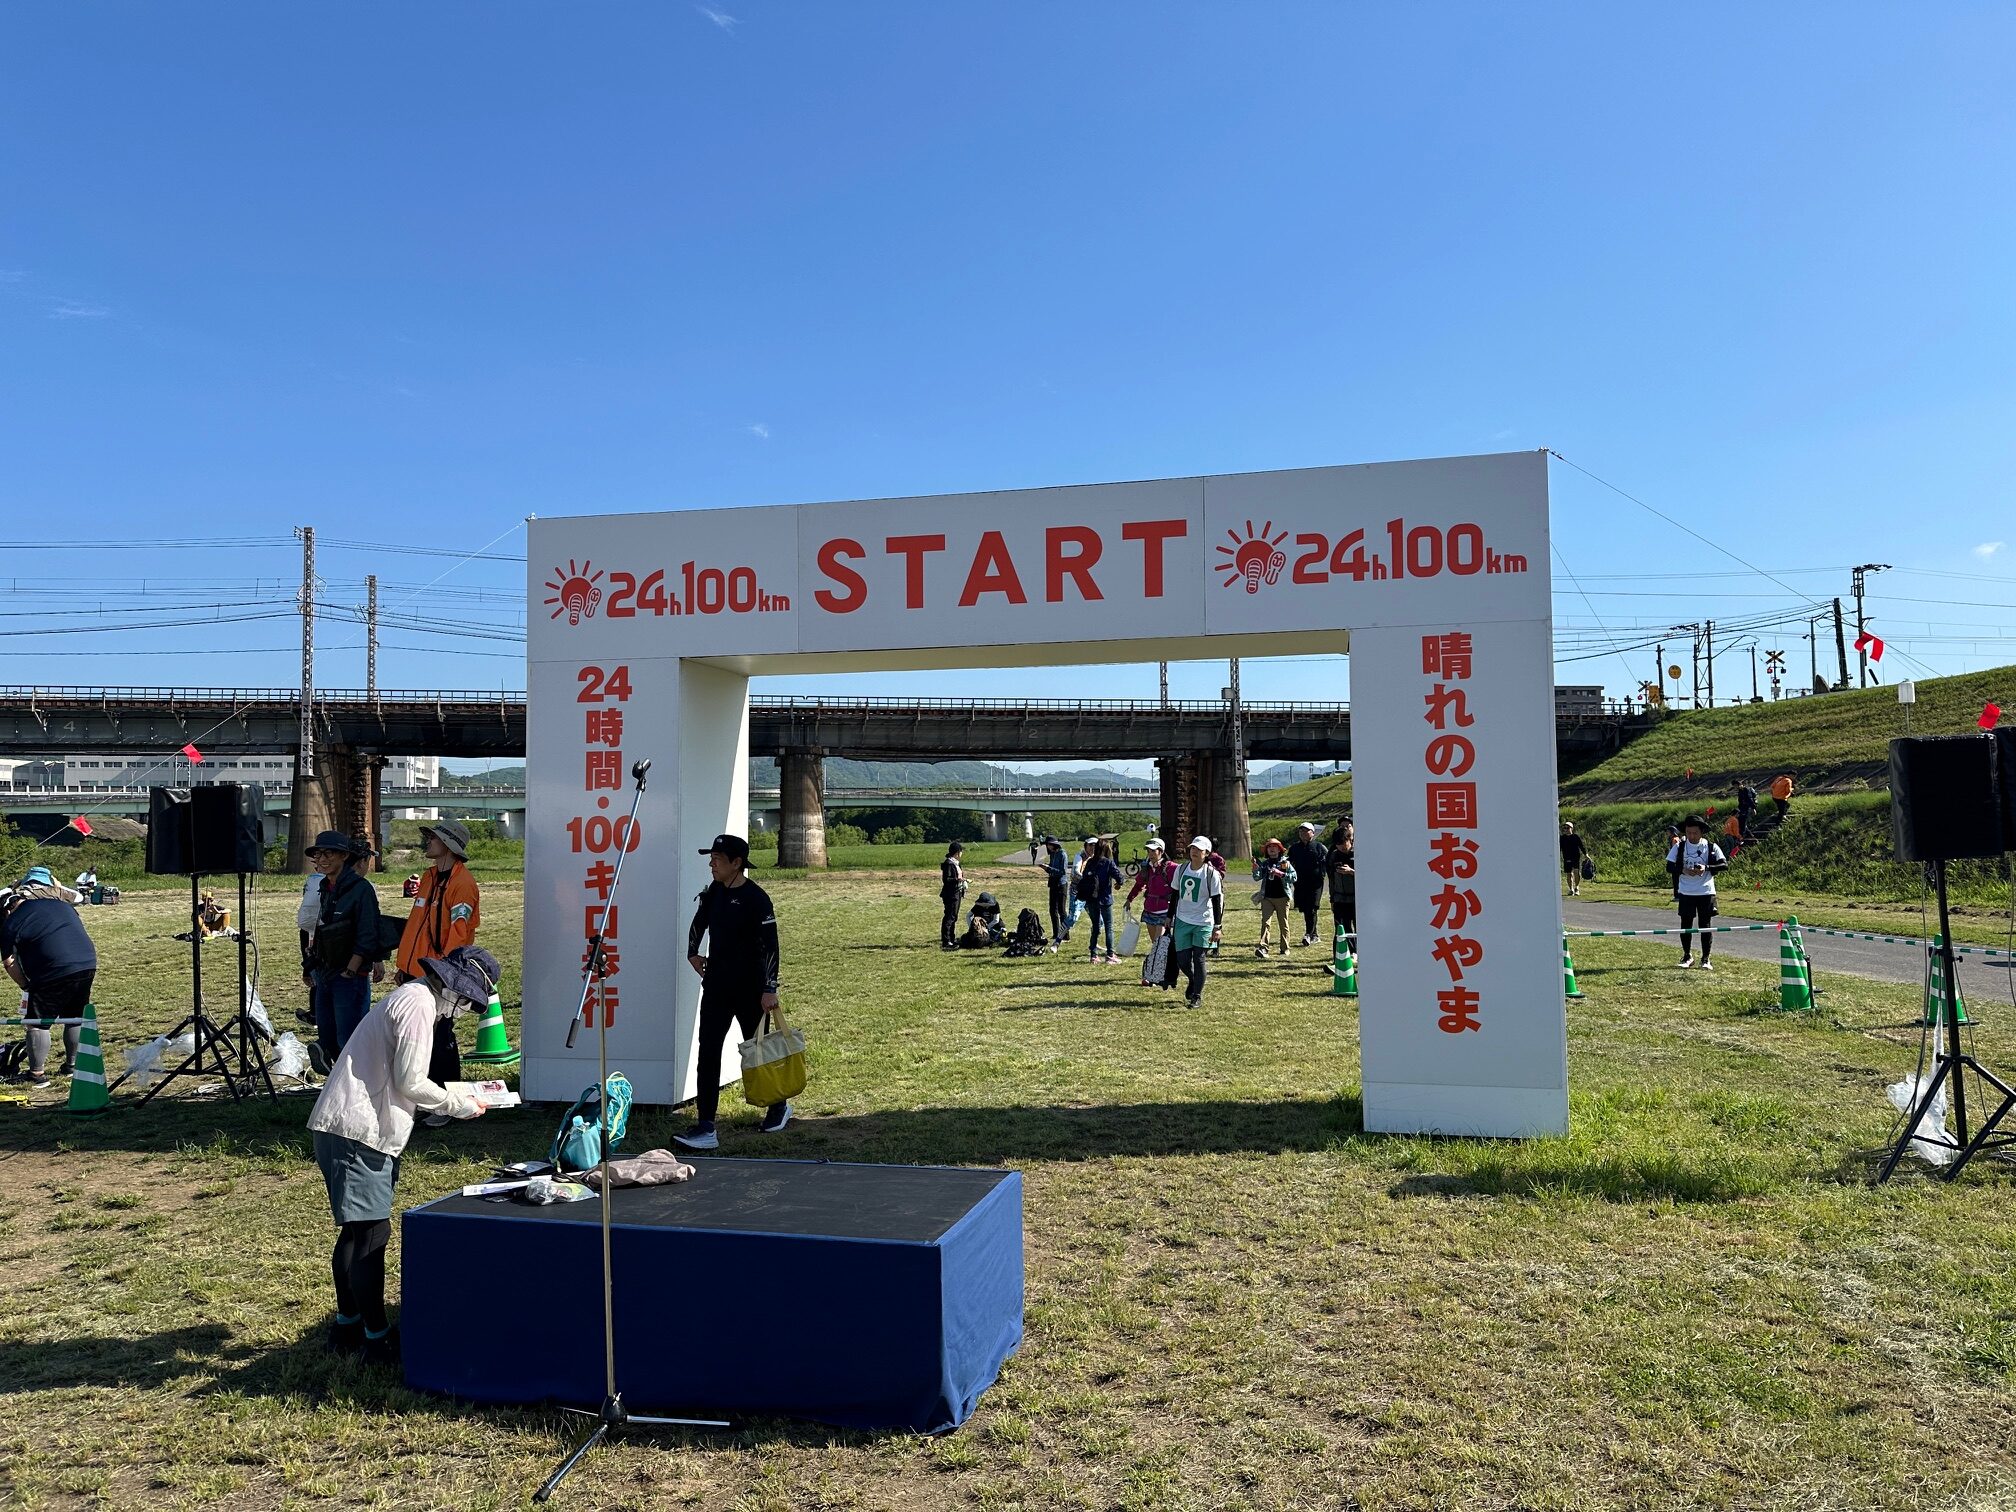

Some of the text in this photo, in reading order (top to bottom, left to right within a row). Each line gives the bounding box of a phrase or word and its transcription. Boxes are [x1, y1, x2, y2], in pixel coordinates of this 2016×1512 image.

[811, 519, 1187, 614] START
[63, 720, 76, 732] 4
[1028, 728, 1039, 739] 2
[1421, 632, 1483, 1033] 晴れの国おかやま
